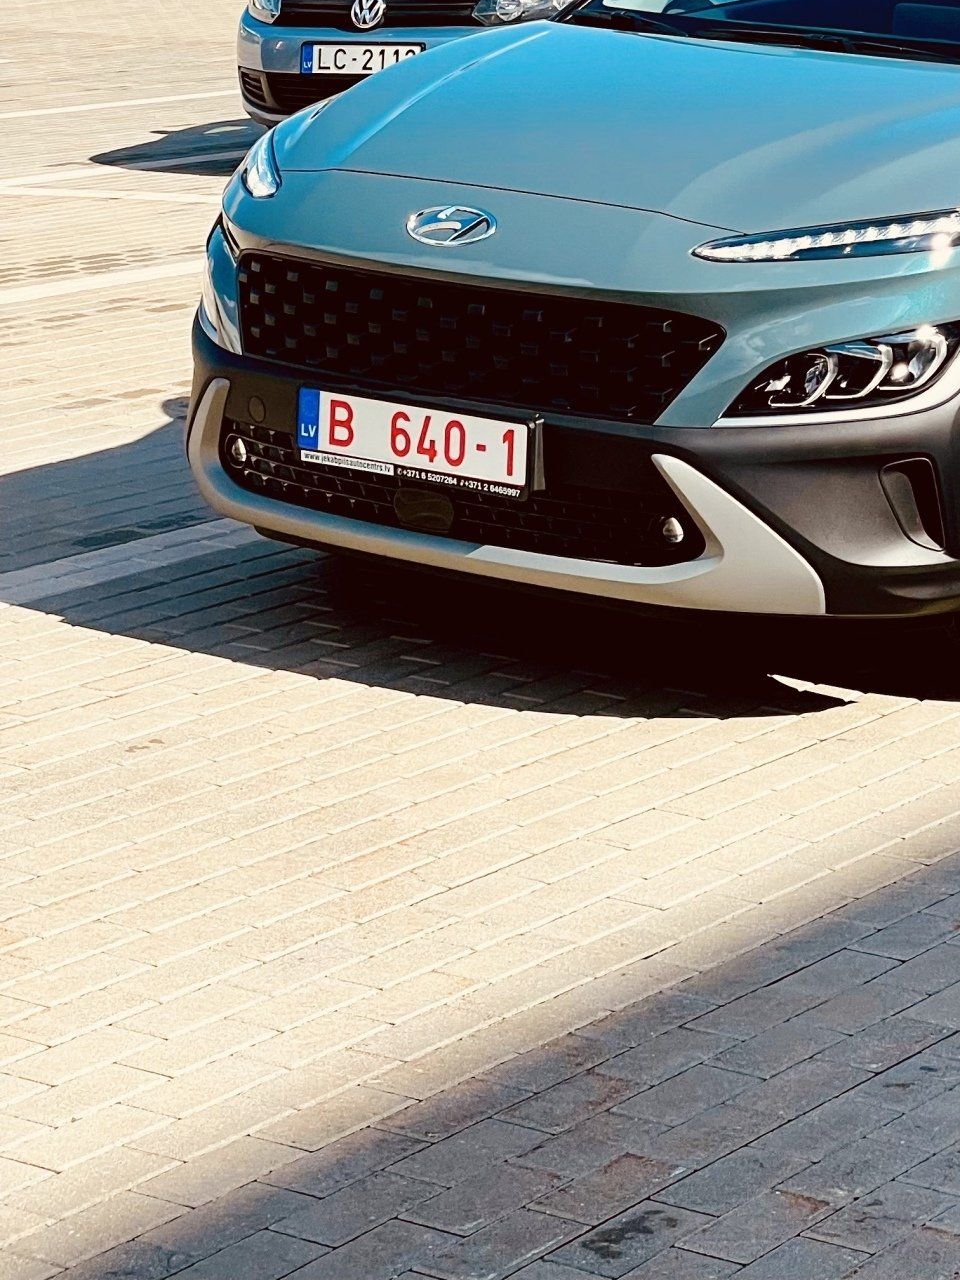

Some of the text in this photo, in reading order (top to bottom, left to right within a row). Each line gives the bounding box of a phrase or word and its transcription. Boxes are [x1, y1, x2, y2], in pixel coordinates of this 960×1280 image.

[301, 424, 316, 438] LV
[329, 399, 515, 477] B 640-1
